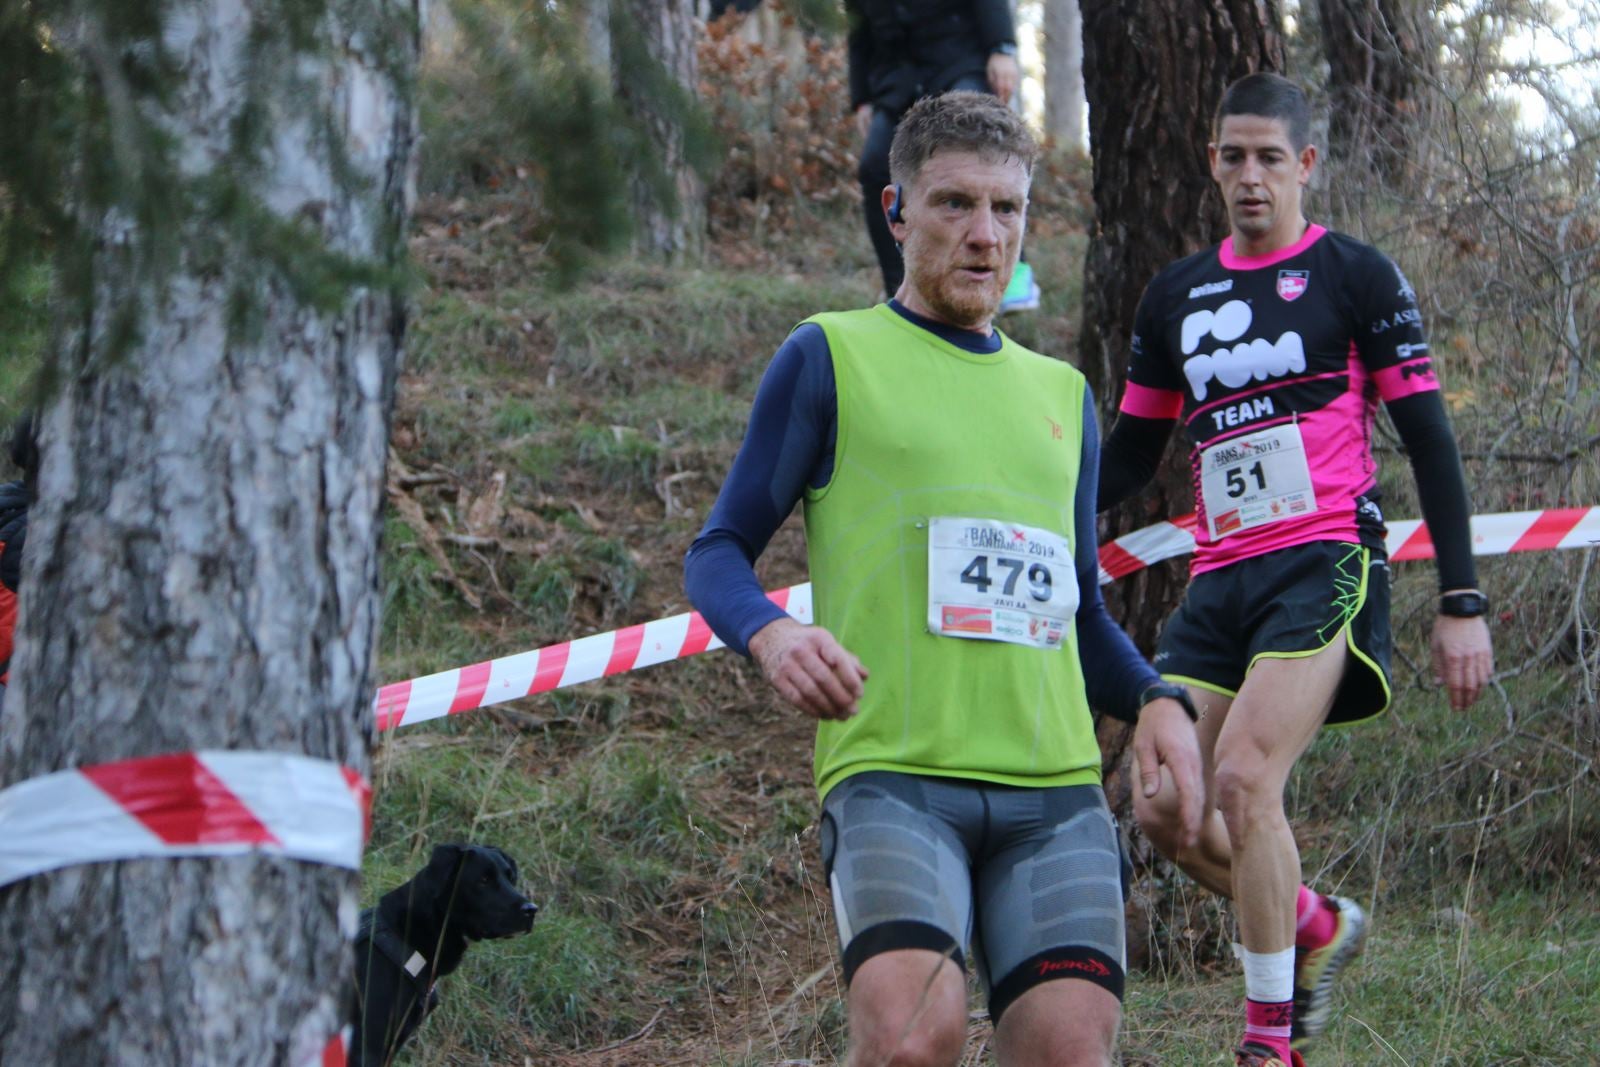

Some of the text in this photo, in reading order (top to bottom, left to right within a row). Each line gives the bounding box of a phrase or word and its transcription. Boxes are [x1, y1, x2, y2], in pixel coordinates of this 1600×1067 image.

[1181, 300, 1253, 355] PO
[1211, 396, 1275, 431] TEAM
[1253, 439, 1281, 455] 2019
[1226, 460, 1267, 499] 51
[1028, 540, 1056, 558] 2019
[960, 554, 1053, 602] 479
[993, 598, 1014, 608] JAVI
